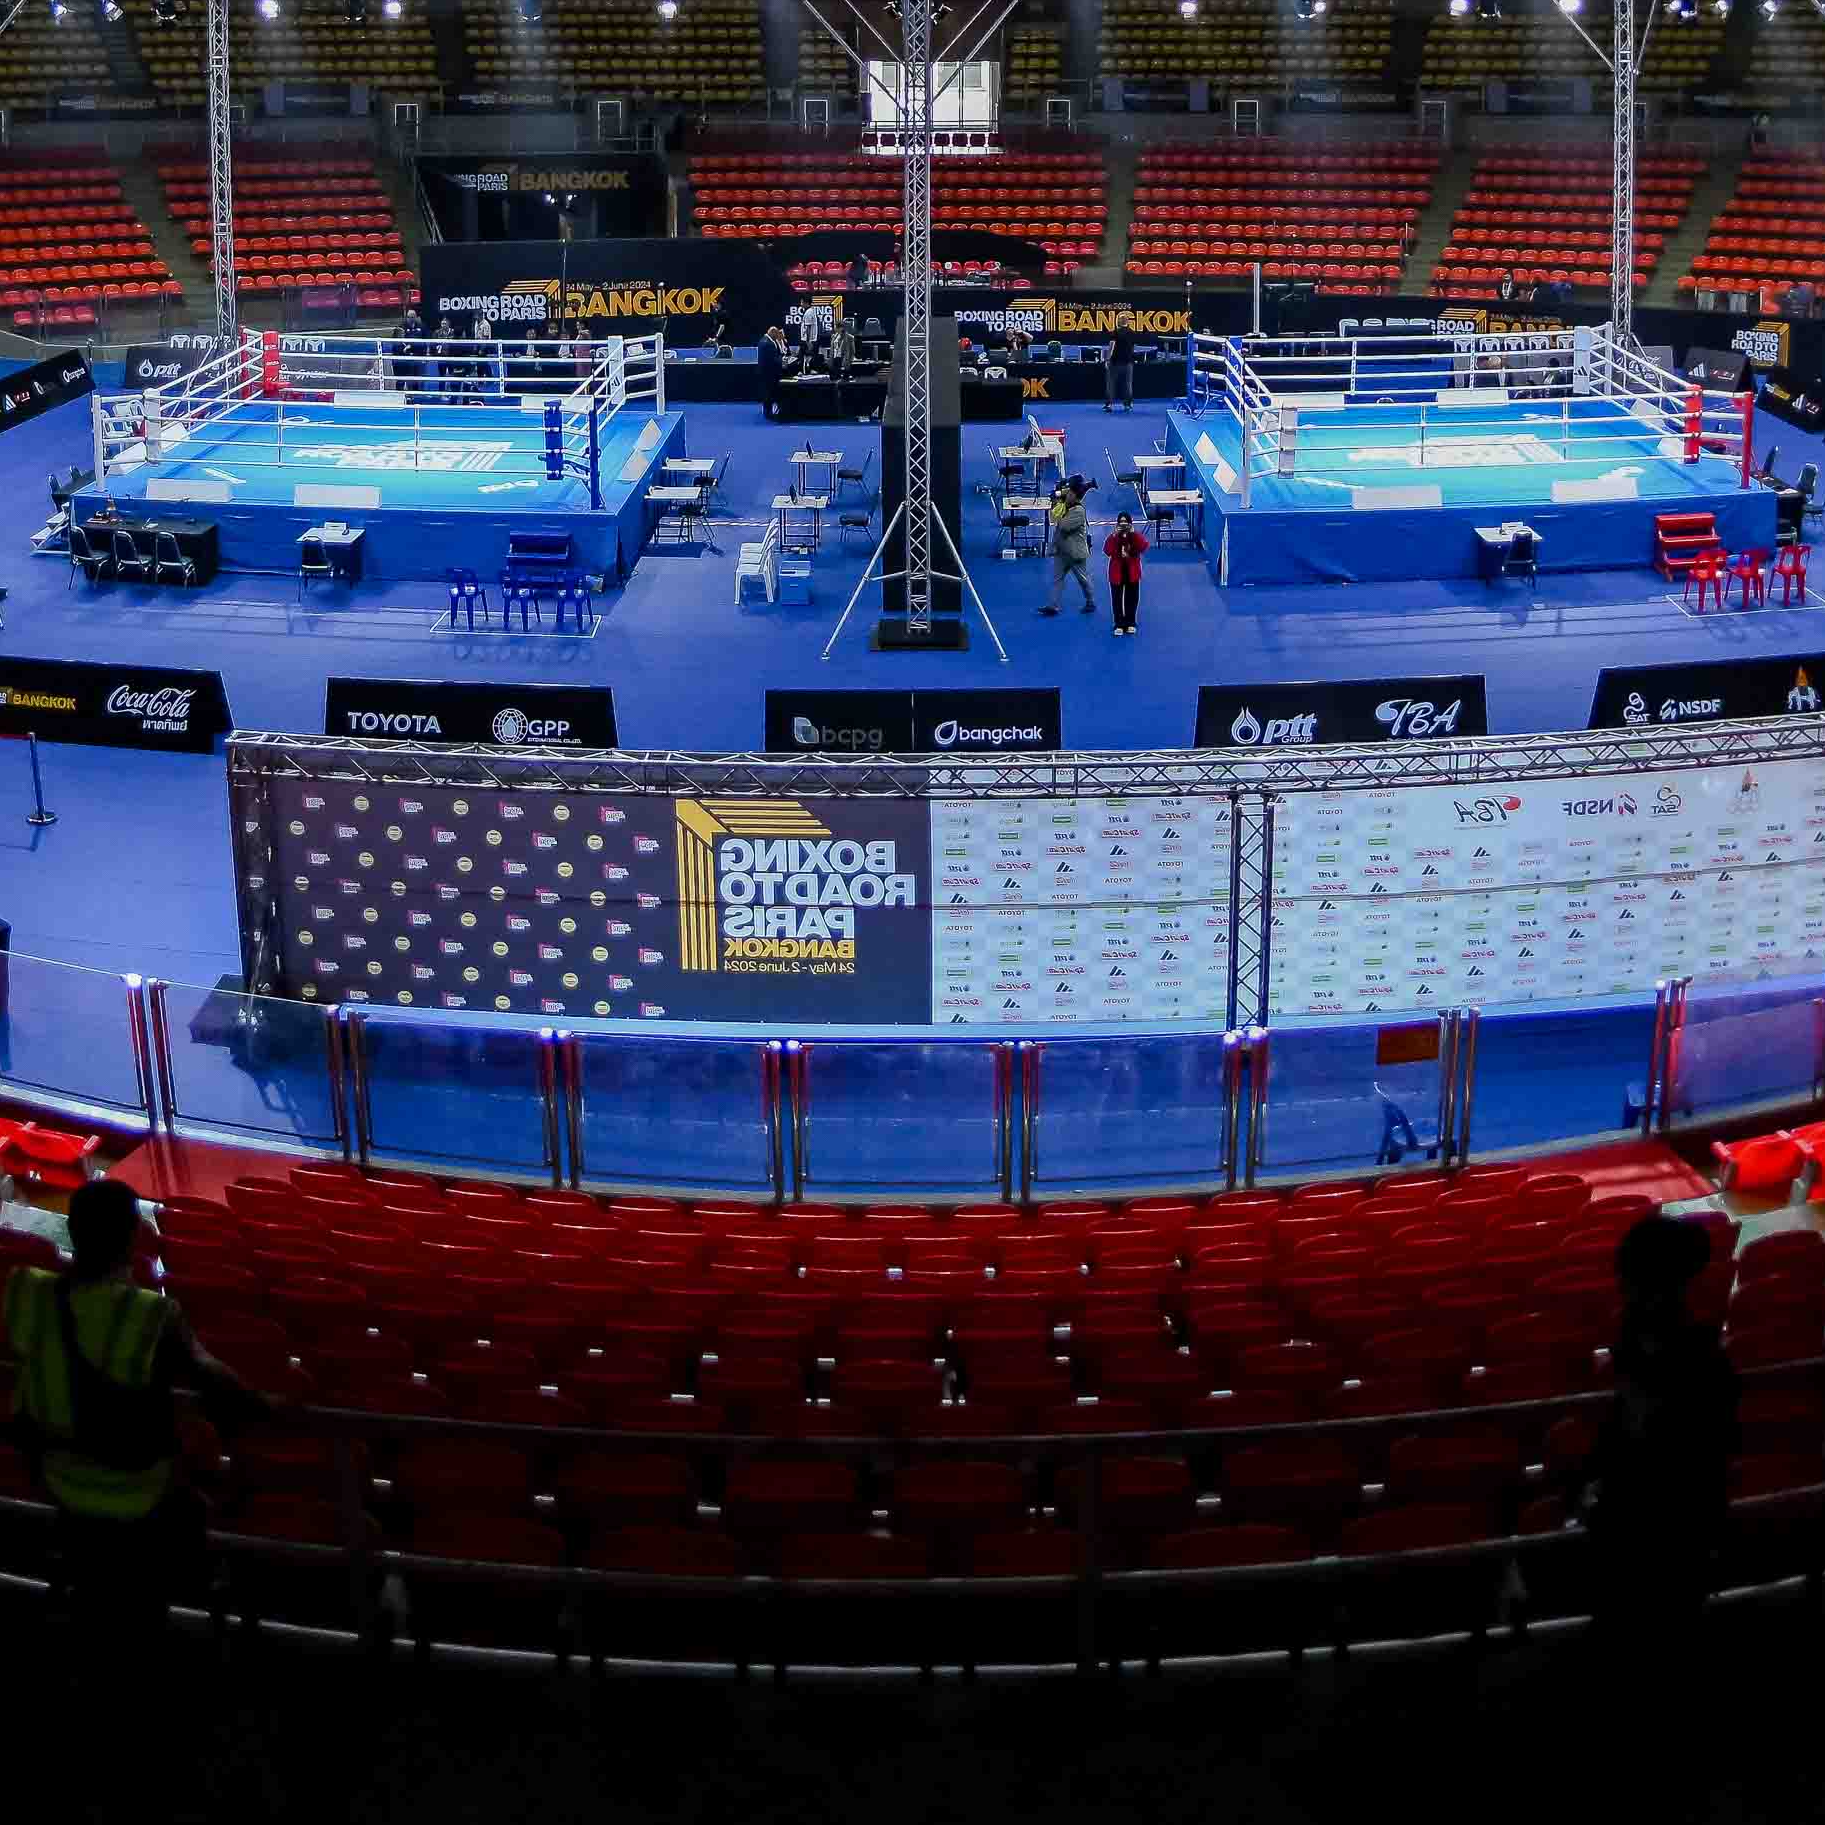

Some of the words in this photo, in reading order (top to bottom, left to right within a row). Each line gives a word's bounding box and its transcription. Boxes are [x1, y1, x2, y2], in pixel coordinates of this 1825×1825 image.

[576, 283, 594, 292] May
[629, 281, 651, 290] 2024
[439, 295, 499, 312] BOXING
[500, 294, 547, 308] ROAD
[565, 287, 724, 319] BANGKOK
[483, 307, 499, 321] TO
[500, 307, 547, 321] PARIS
[789, 306, 833, 317] BOING
[954, 311, 1005, 322] BOXING
[1006, 310, 1043, 321] ROAD
[988, 322, 1003, 332] TO
[1006, 321, 1043, 332] PARIS
[1059, 310, 1191, 332] BANGKOK
[1438, 320, 1474, 331] ROAD
[1736, 330, 1779, 343] BOXING
[1745, 350, 1778, 363] PARIS
[154, 359, 182, 377] ptt
[13, 693, 76, 710] BANGKOK
[107, 684, 198, 718] Coca-Cola
[1679, 699, 1721, 716] NSDF
[347, 711, 442, 734] TOYOTA
[1627, 714, 1649, 723] SAT
[528, 720, 570, 736] GPP
[959, 725, 1043, 744] bangchak
[1262, 713, 1317, 744] ptt
[822, 726, 883, 750] bcpg
[1281, 735, 1312, 744] Group
